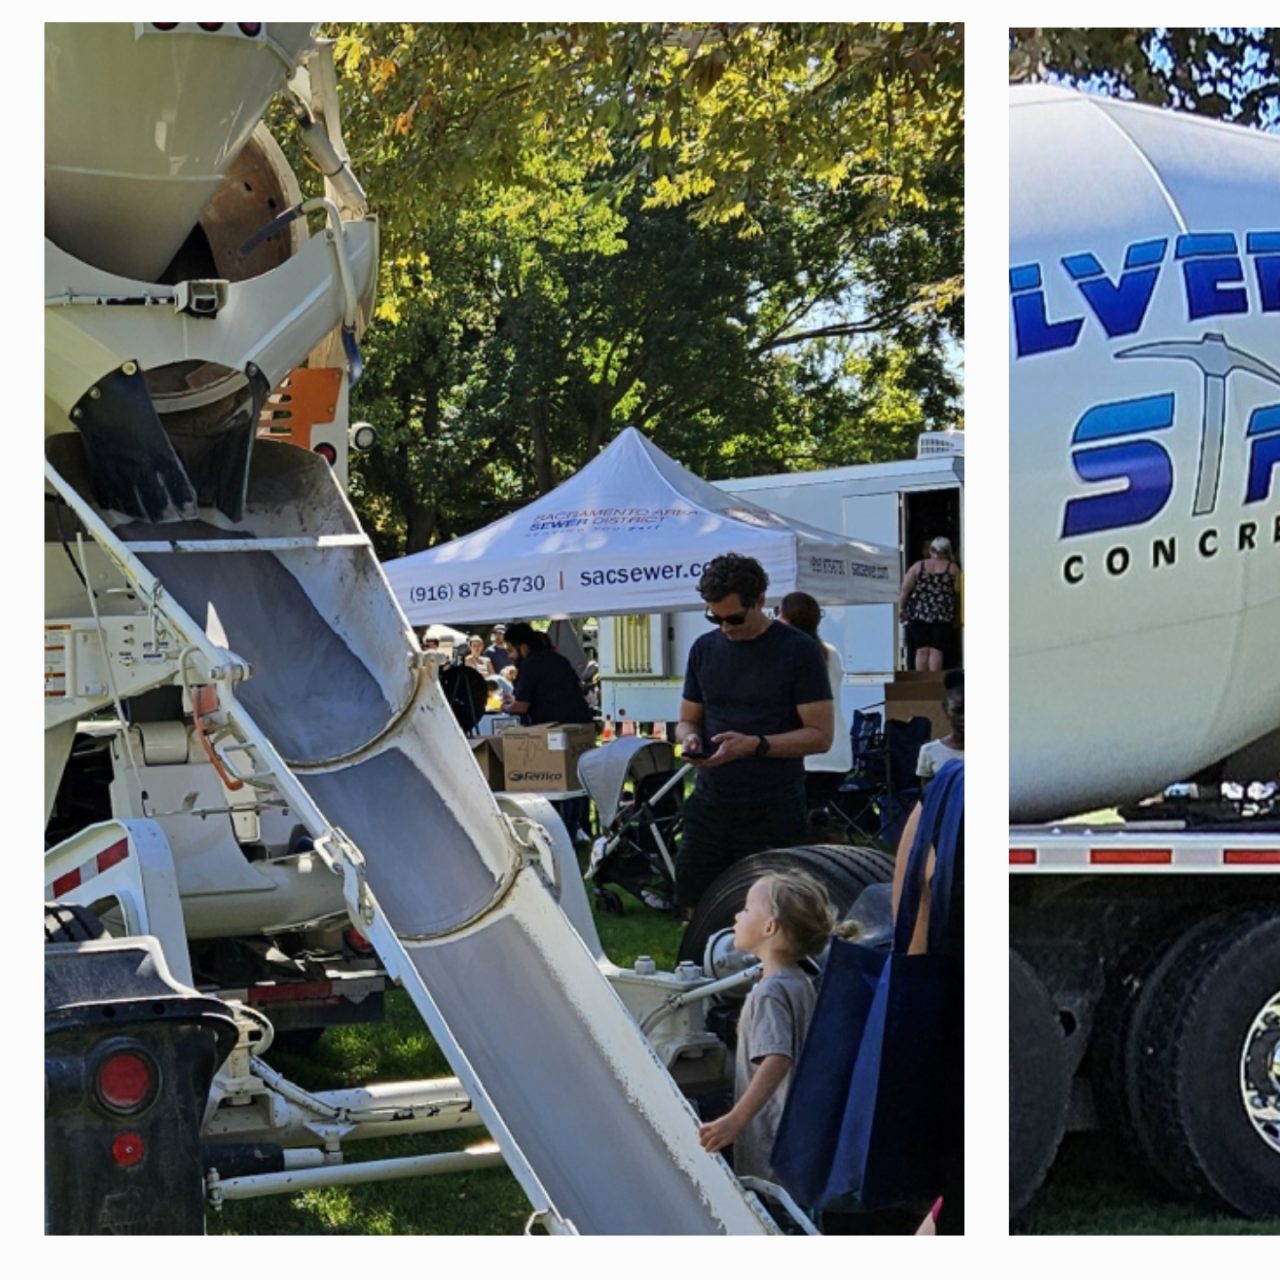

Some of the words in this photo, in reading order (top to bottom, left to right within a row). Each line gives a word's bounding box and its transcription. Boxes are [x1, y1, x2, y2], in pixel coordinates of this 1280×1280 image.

[529, 518, 589, 532] SEWER
[591, 516, 665, 526] DISTRICT
[409, 583, 454, 603] (916)
[458, 575, 545, 599] 875-6730
